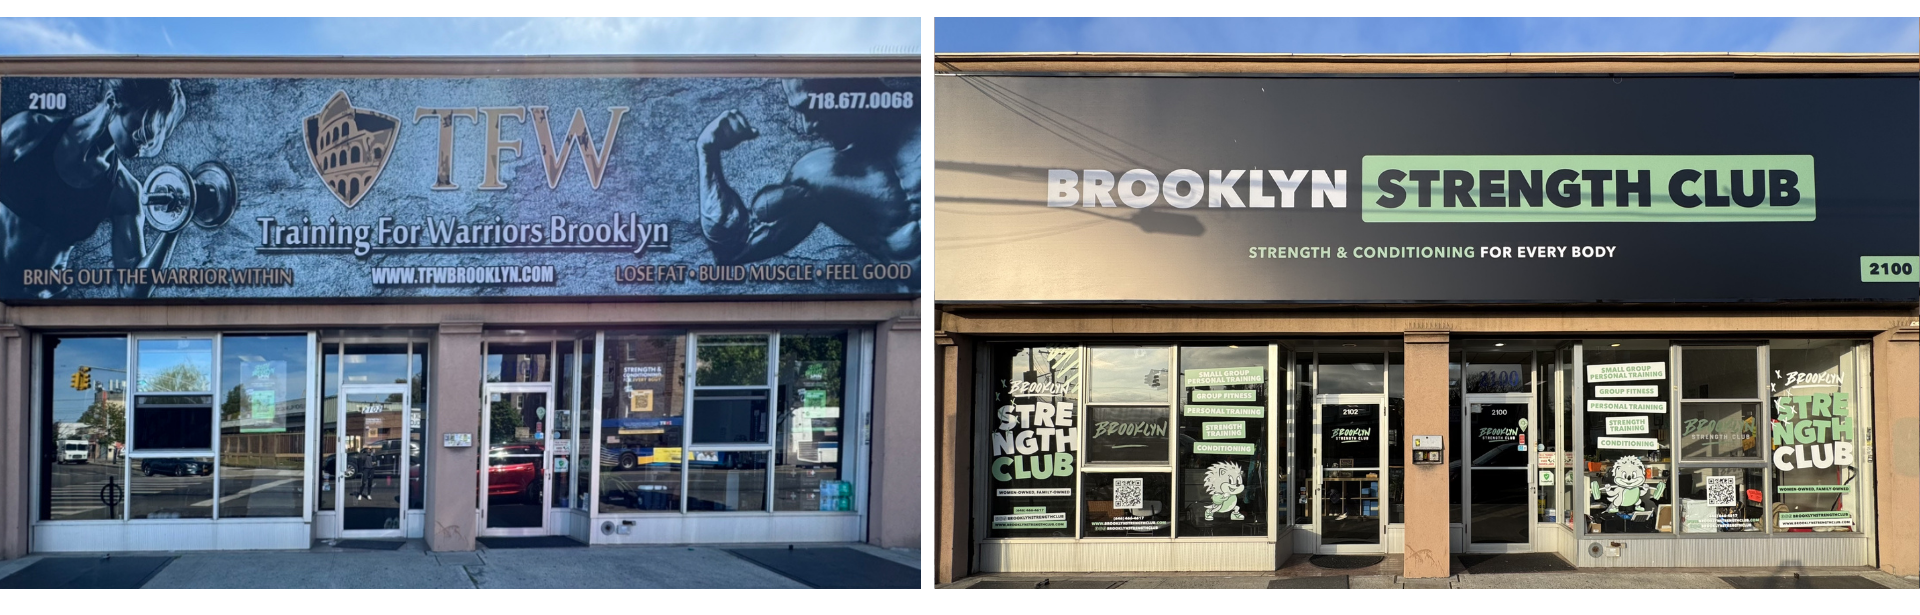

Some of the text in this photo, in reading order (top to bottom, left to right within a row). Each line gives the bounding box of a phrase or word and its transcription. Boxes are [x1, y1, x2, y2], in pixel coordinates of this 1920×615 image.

[29, 92, 67, 110] 2100
[807, 91, 914, 110] 718.677.0068
[412, 105, 630, 192] TFW
[1047, 168, 1801, 209] BROOKLYN STRENGTH CLUB
[256, 212, 669, 256] Training For Warriors Brooklyn
[1248, 245, 1617, 259] STRENGTH & CONDITIONING FOR EVERY BODY
[23, 268, 293, 286] BRING OUT THE WARRIOR WITHIN
[371, 265, 554, 285] WWW.TFWBROOKLYN.COM
[615, 264, 912, 282] LOSE FAT BUILD MUSCLE FEEL GOOD
[1869, 262, 1913, 275] 2100
[1008, 380, 1070, 395] BROOKLYN
[1226, 375, 1261, 383] TRAINING
[1784, 371, 1844, 386] BROOKLYN
[997, 402, 1074, 431] STRE
[1342, 408, 1359, 416] 2102
[1775, 392, 1849, 422] STRE
[1092, 420, 1168, 439] BROOKLYN
[1330, 426, 1371, 439] BROOKLYN
[1478, 427, 1519, 438] BROOKLYN
[1682, 416, 1755, 437] BROOKLYN
[1773, 416, 1853, 445] NGTH
[991, 427, 1078, 457] NGTH
[1773, 441, 1853, 471] CLUB
[991, 452, 1074, 482] CLUB
